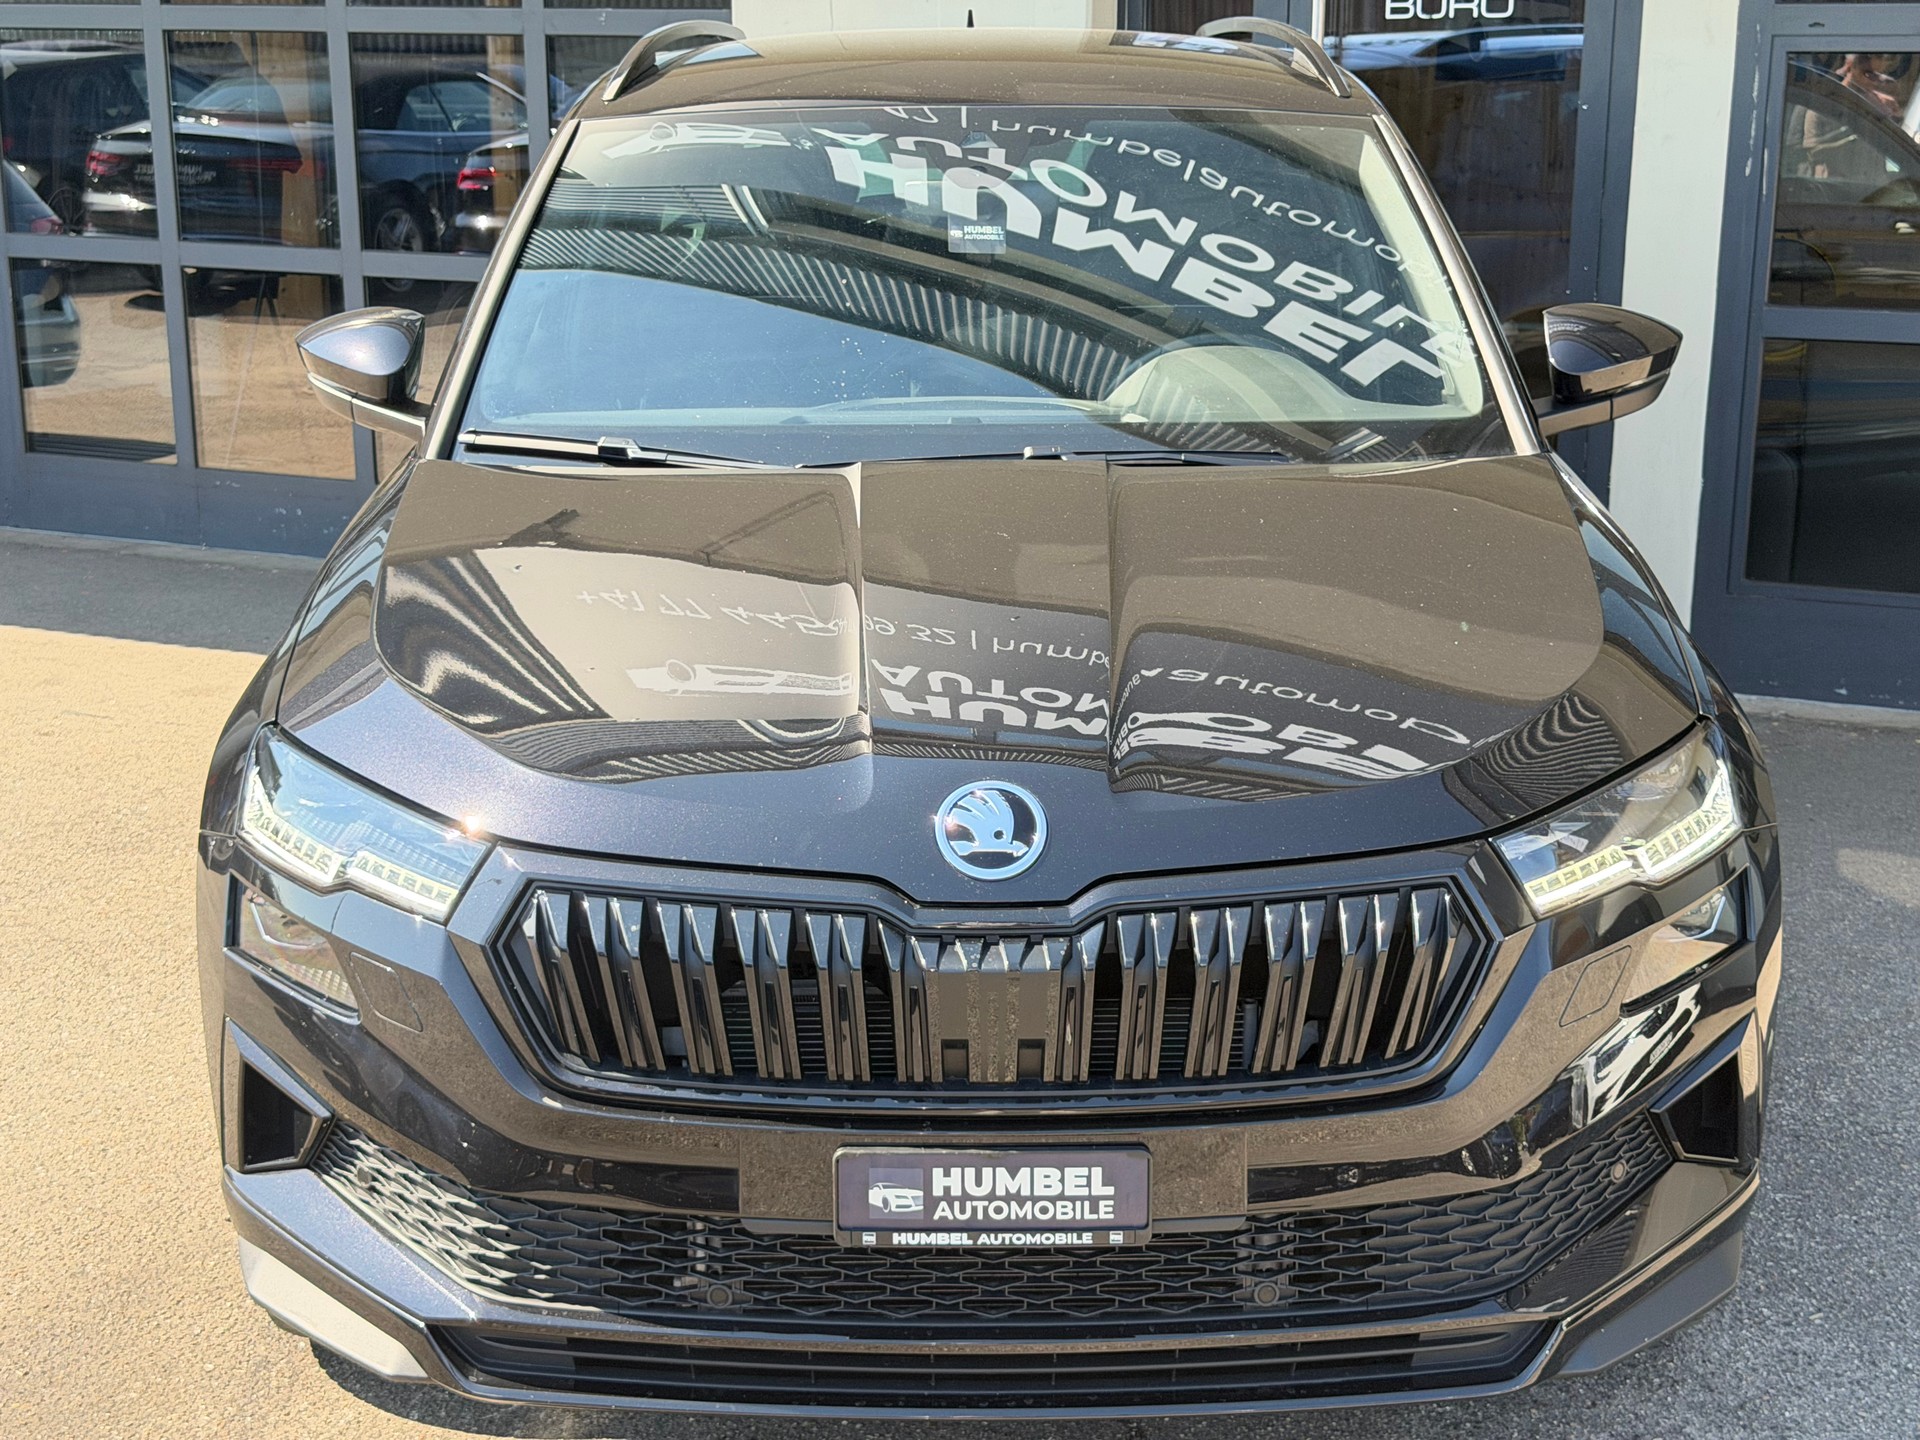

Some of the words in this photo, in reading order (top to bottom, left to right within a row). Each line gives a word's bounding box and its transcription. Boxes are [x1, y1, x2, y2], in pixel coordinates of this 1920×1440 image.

[963, 225, 1005, 235] HUMBEL
[932, 1167, 1115, 1197] HUMBEL
[933, 1200, 1115, 1220] AUTOMOBILE
[892, 1232, 973, 1246] HUMBEL
[976, 1232, 1093, 1245] AUTOMOBILE
